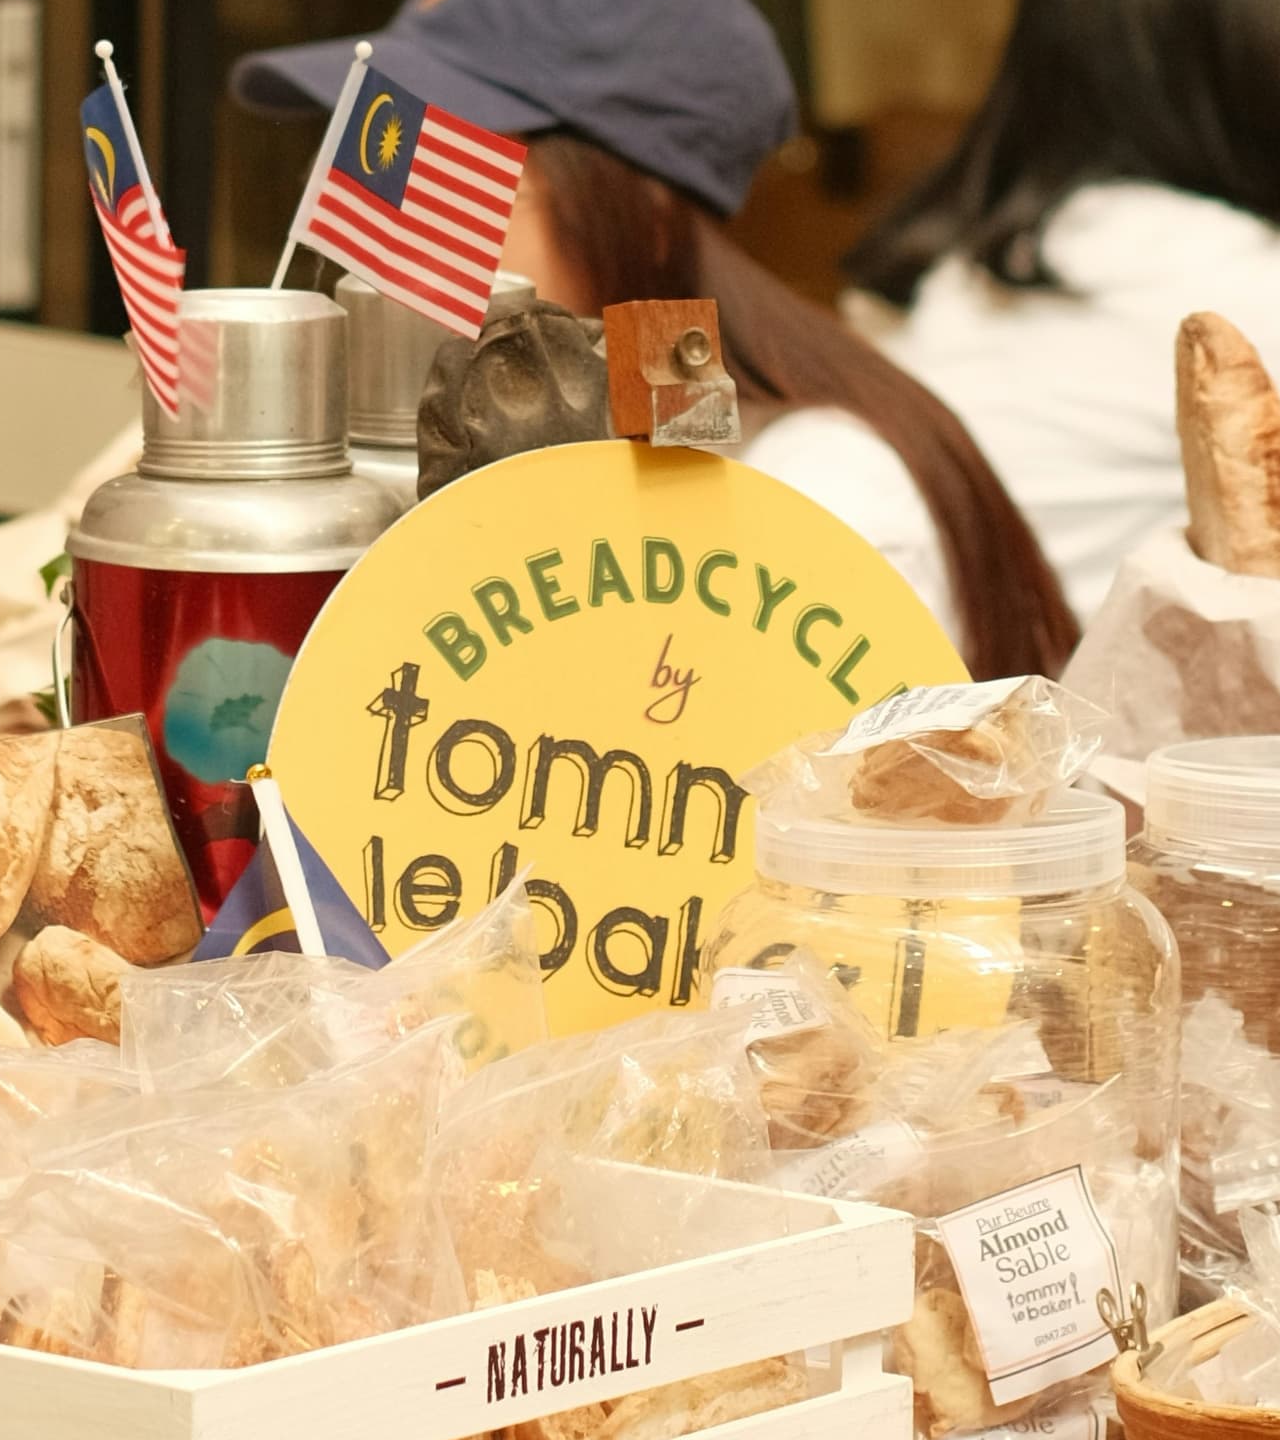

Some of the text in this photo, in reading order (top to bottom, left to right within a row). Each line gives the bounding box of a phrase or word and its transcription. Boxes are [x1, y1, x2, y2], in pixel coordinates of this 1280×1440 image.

[423, 536, 908, 706] BREADCYCL
[645, 634, 702, 723] by
[365, 662, 756, 864] tomm
[362, 835, 462, 932] le
[976, 1198, 1051, 1234] Pur Beurre
[979, 1209, 1070, 1262] Almond
[996, 1240, 1070, 1283] Sable
[1007, 1278, 1067, 1309] tommy
[1026, 1298, 1072, 1321] baker
[487, 1304, 658, 1404] NATURALLY
